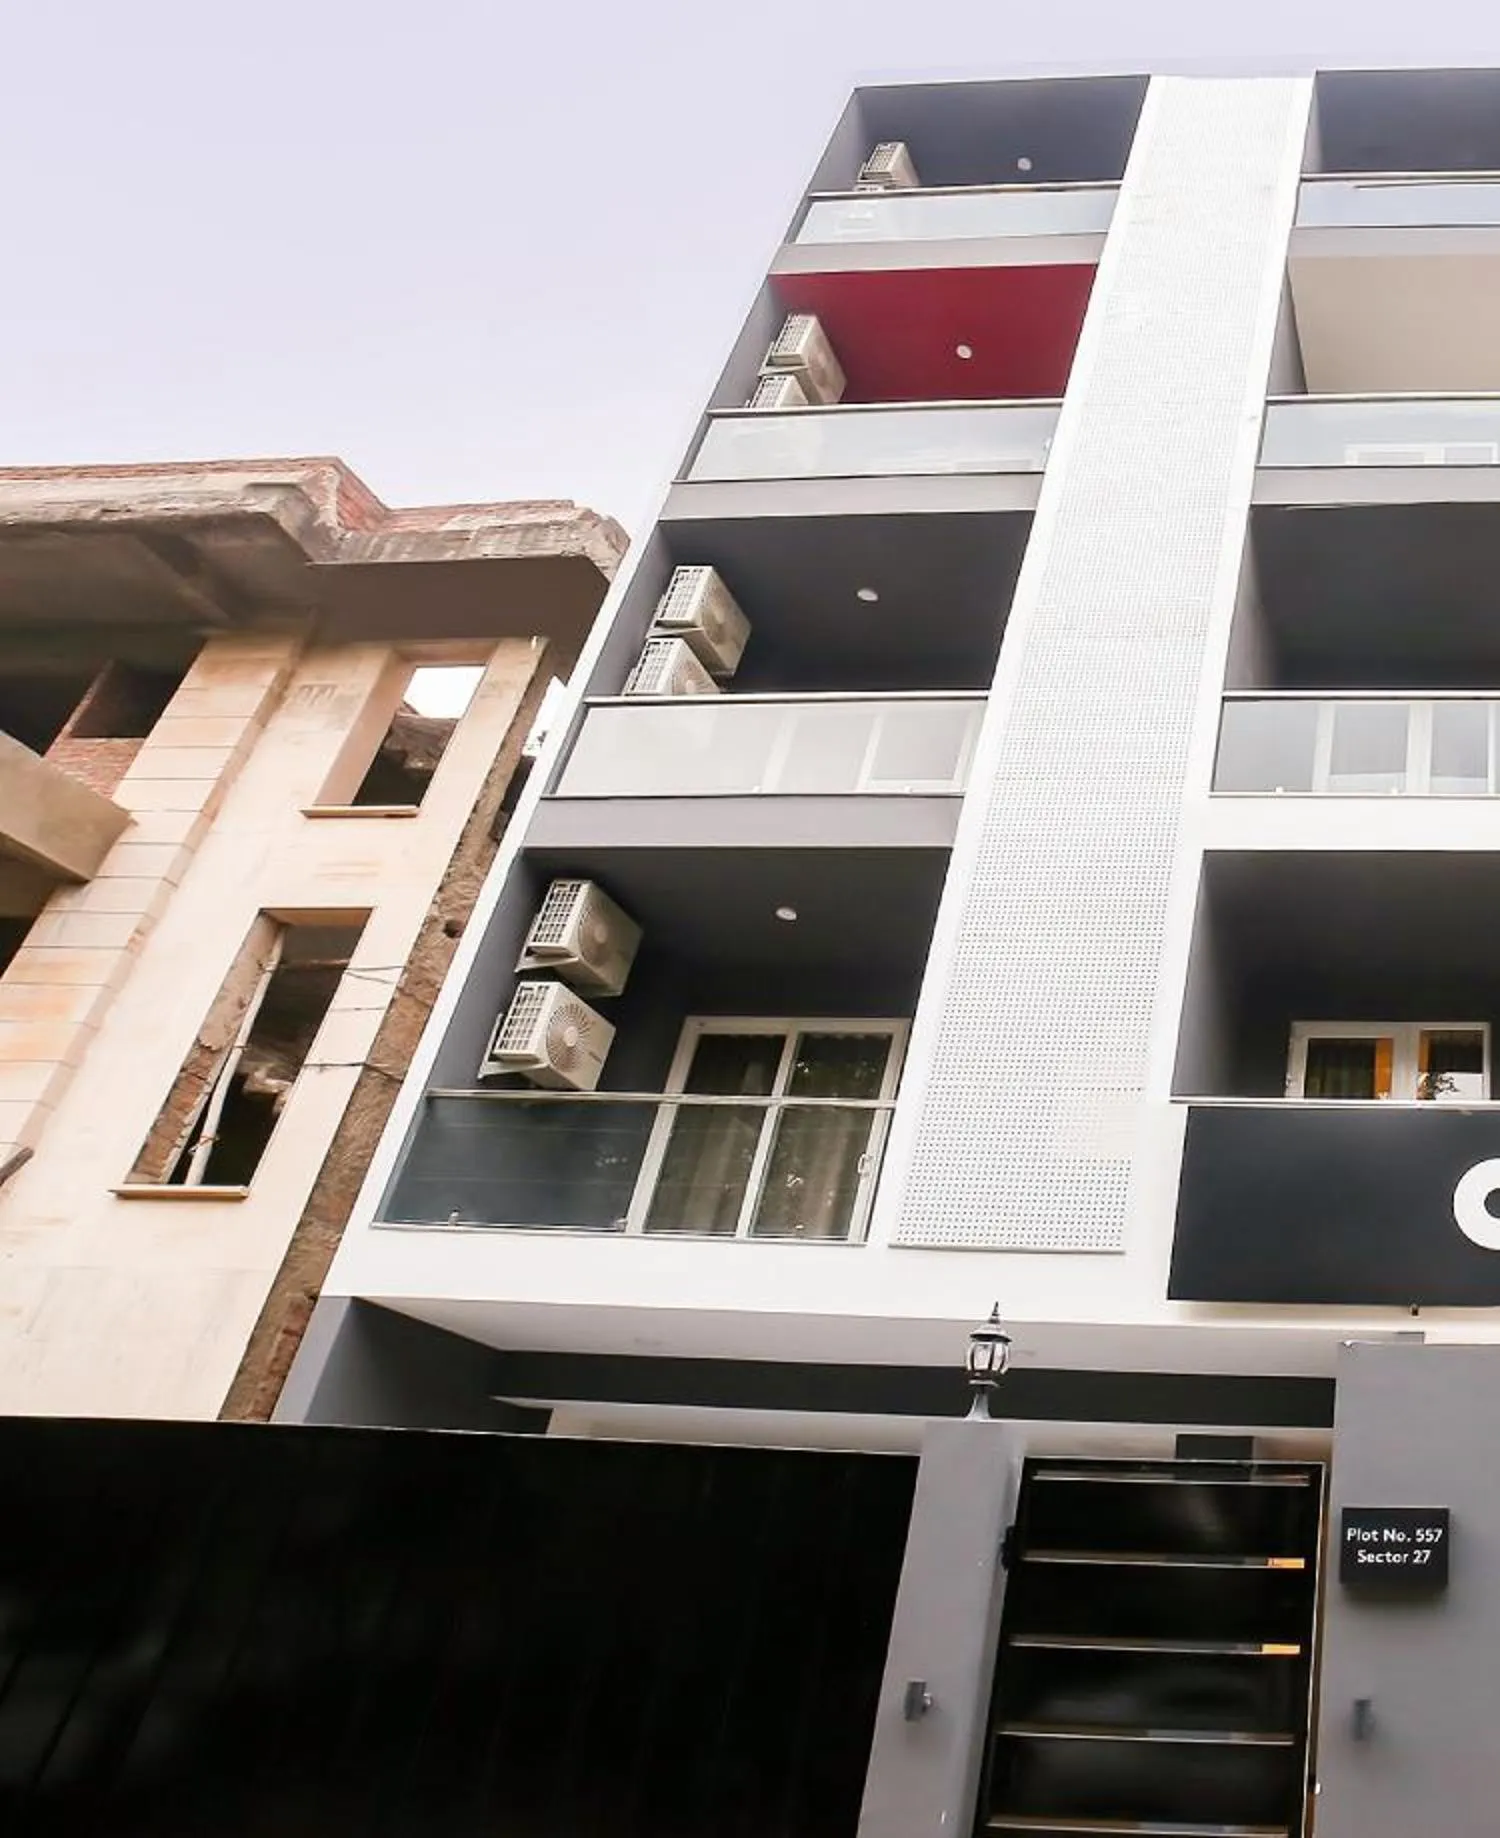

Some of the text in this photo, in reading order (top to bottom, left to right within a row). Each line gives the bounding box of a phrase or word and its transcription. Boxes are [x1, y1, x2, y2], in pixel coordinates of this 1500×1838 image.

[1346, 1527, 1443, 1543] Plot No. 557
[1357, 1549, 1432, 1564] Sector 27
